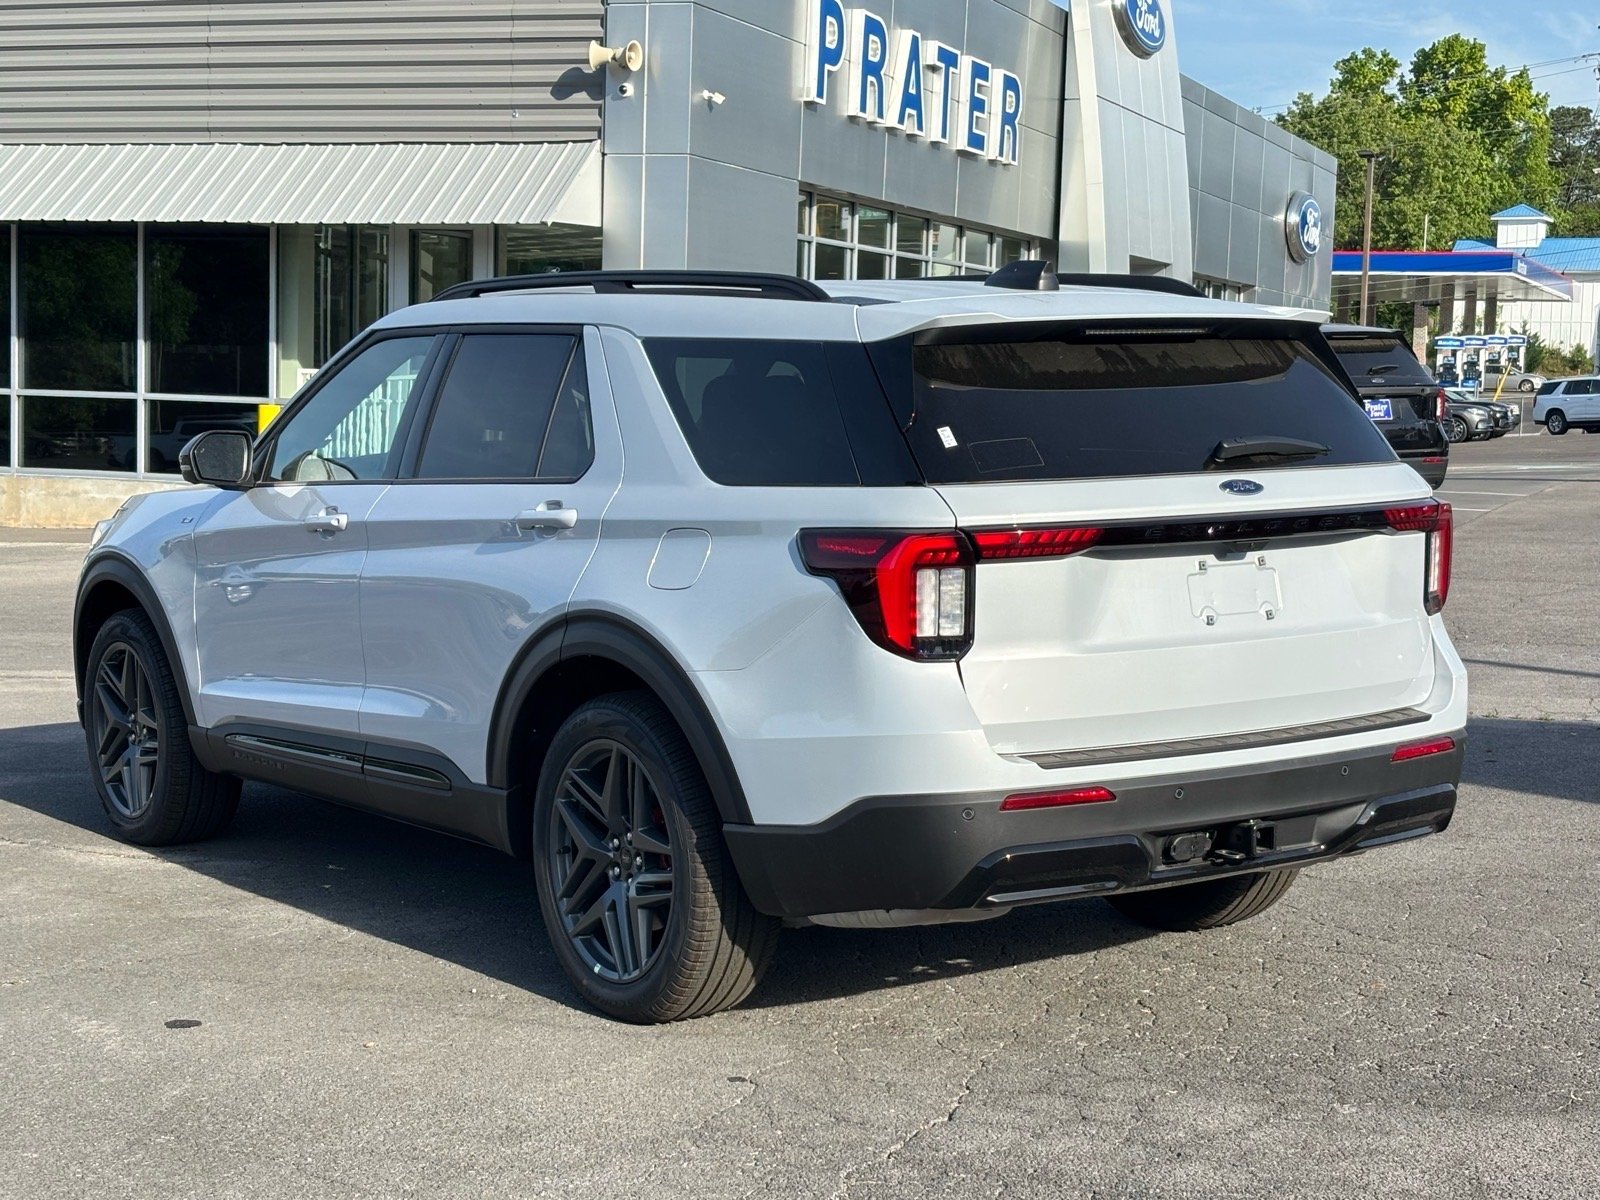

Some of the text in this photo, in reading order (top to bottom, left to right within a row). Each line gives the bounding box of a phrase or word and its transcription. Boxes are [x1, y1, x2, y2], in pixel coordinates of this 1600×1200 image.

[1136, 0, 1161, 38] Ford
[812, 0, 1023, 165] PRATER
[1303, 207, 1321, 246] Ford
[1231, 481, 1256, 491] Ford
